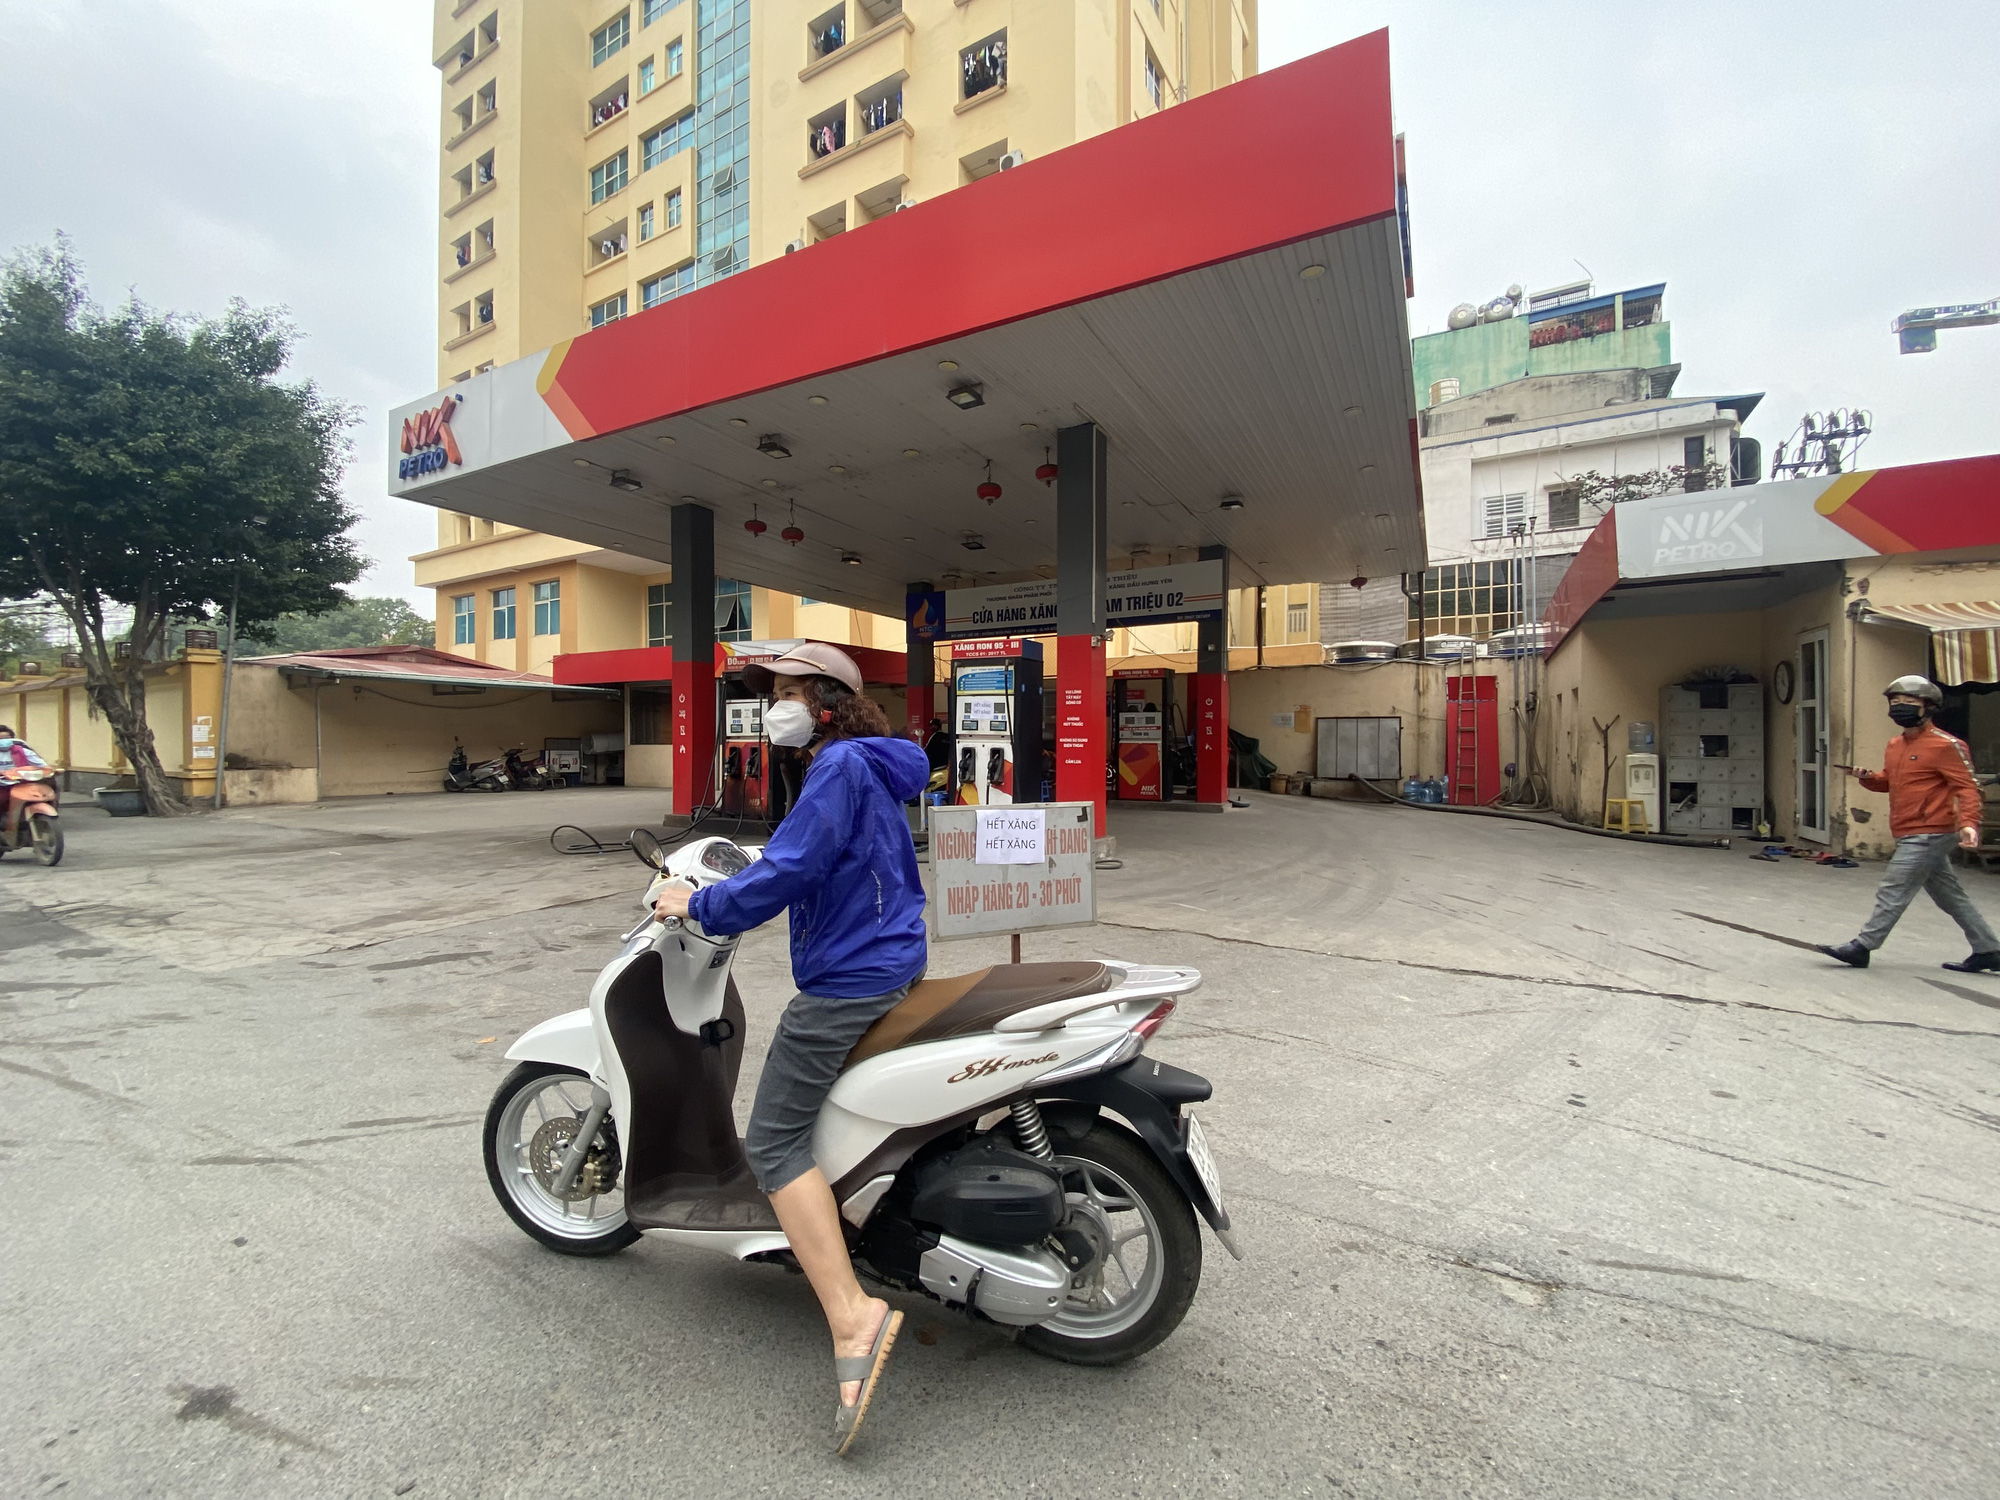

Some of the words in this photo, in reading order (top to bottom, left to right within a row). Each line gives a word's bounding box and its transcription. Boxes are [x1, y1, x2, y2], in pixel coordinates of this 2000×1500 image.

[401, 395, 462, 465] NIK
[399, 448, 448, 479] PETRO
[1659, 500, 1763, 555] NIK
[1654, 541, 1736, 564] PETRO
[1013, 585, 1034, 593] CÔNG
[972, 606, 994, 624] CỬA
[996, 607, 1026, 622] HÀNG
[1126, 592, 1163, 612] TRIỆU
[1166, 591, 1184, 607] 02
[727, 656, 738, 666] DO
[954, 642, 975, 651] XĂNG
[976, 641, 993, 650] RON
[1010, 641, 1019, 649] III
[986, 817, 1005, 830] HẾT
[1007, 817, 1036, 830] XĂNG
[937, 826, 976, 860] NGỪNG
[1045, 828, 1057, 855] HI
[1060, 827, 1088, 854] ĐANG
[985, 837, 1005, 849] HẾT
[1007, 838, 1036, 849] XĂNG
[947, 880, 979, 919] NHẬP
[982, 880, 1013, 912] HÀNG
[1016, 881, 1029, 909] 20
[1039, 880, 1053, 907] 30
[1055, 873, 1082, 905] PHÚT
[947, 1055, 1011, 1083] SH
[1002, 1051, 1060, 1071] mode
